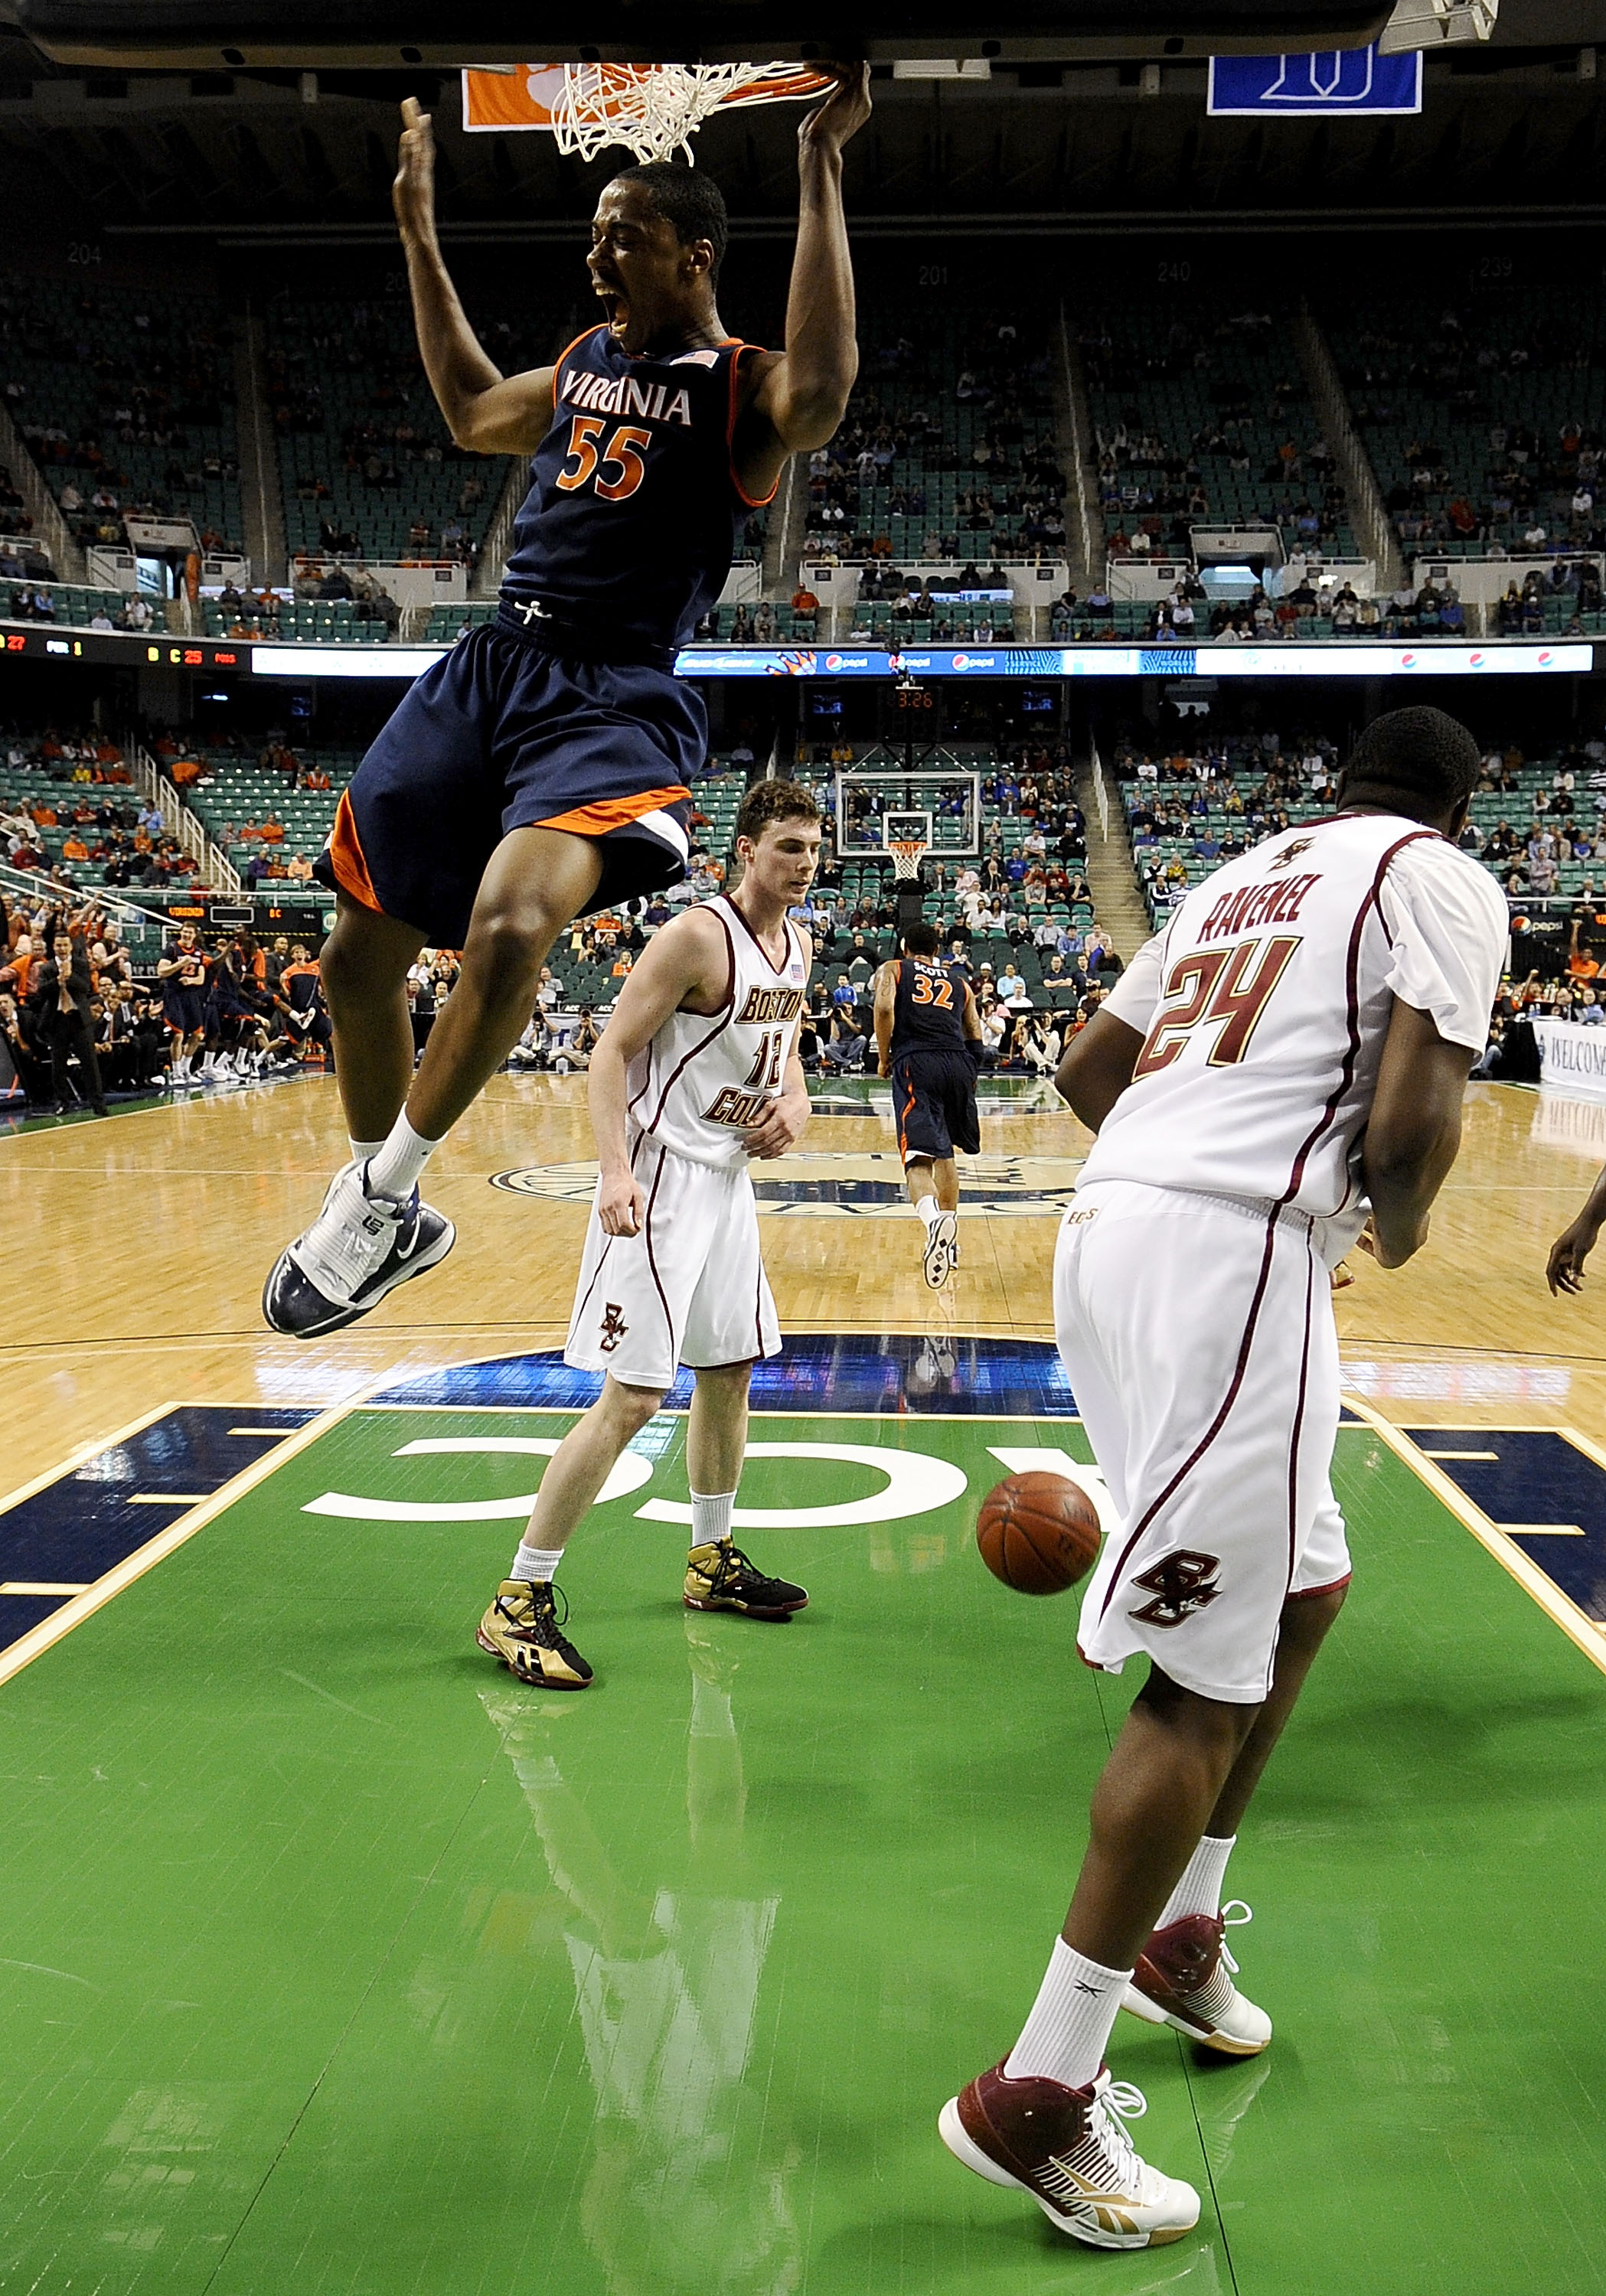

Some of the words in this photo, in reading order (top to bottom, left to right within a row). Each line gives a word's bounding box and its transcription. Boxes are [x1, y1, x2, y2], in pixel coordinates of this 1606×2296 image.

[67, 240, 103, 264] 204
[918, 264, 948, 285] 201
[1157, 260, 1192, 282] 240
[1480, 256, 1513, 278] 239
[560, 370, 691, 426] VIRGINIA
[555, 415, 652, 501] 55
[7, 634, 26, 651] 27
[842, 657, 868, 669] pepsi
[968, 657, 995, 668] pepsi
[898, 692, 933, 709] 3:26
[1196, 873, 1324, 944] RAVENEL
[1533, 921, 1564, 932] pepsi
[913, 961, 948, 978] SCOTT
[912, 974, 954, 1010] 32
[1131, 935, 1304, 1084] 24
[743, 1029, 784, 1089] 12
